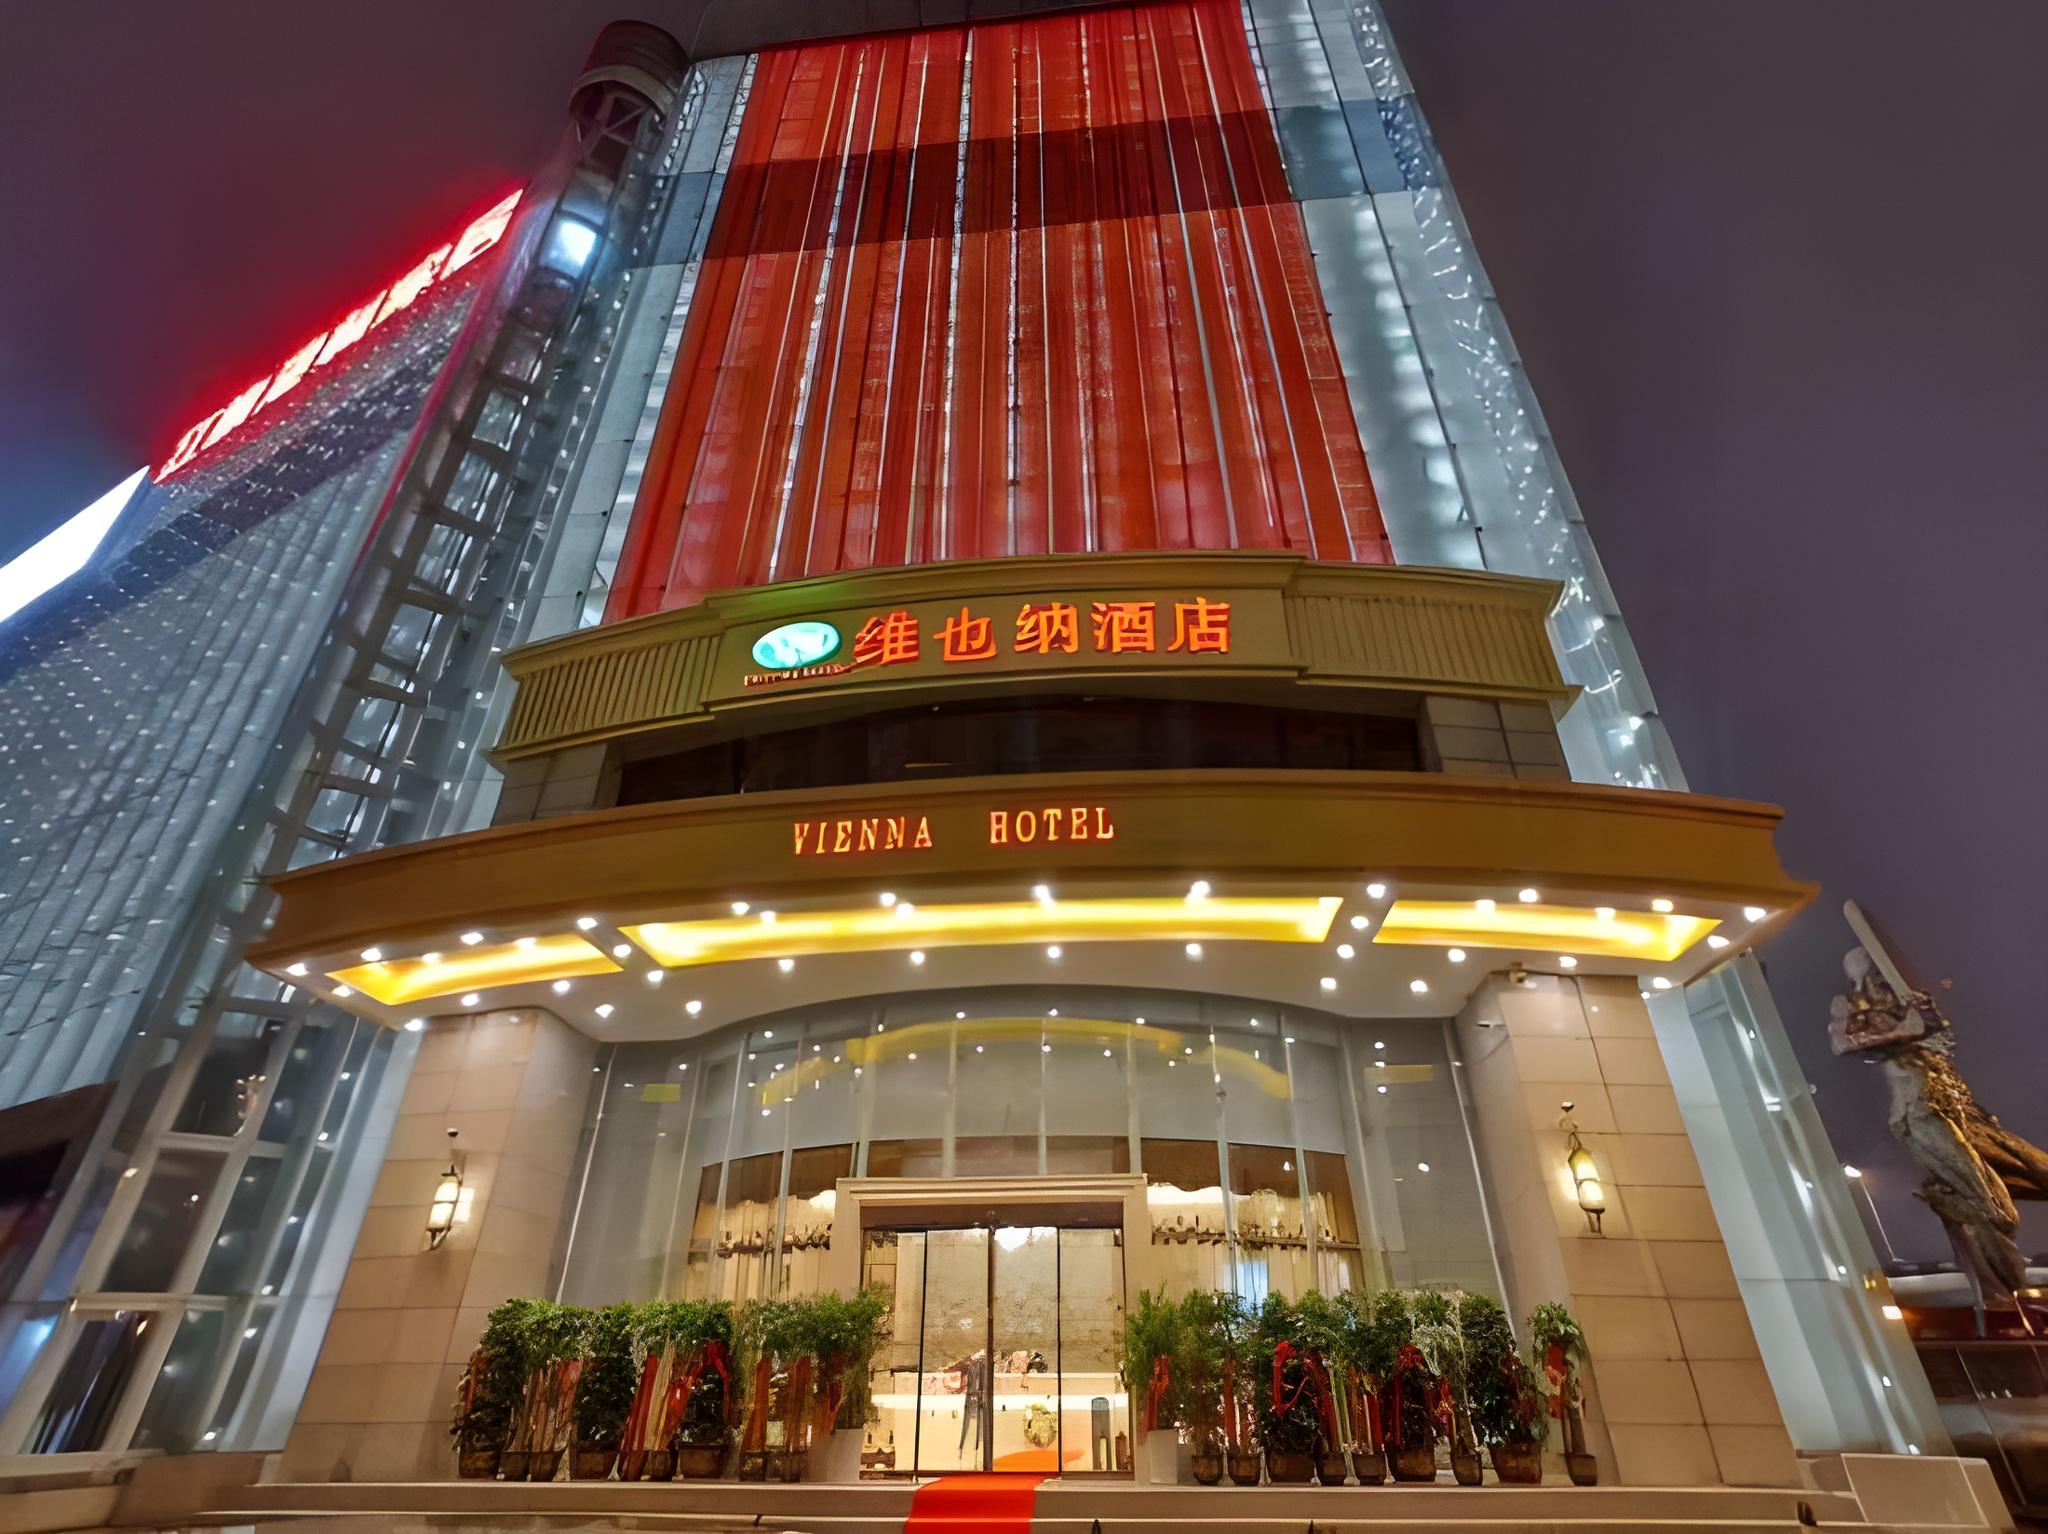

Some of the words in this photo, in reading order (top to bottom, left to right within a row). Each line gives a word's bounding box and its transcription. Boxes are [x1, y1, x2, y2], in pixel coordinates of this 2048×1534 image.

[854, 597, 1231, 665] 维也纳酒店
[793, 816, 933, 855] VIENNA
[989, 807, 1114, 844] HOTEL
